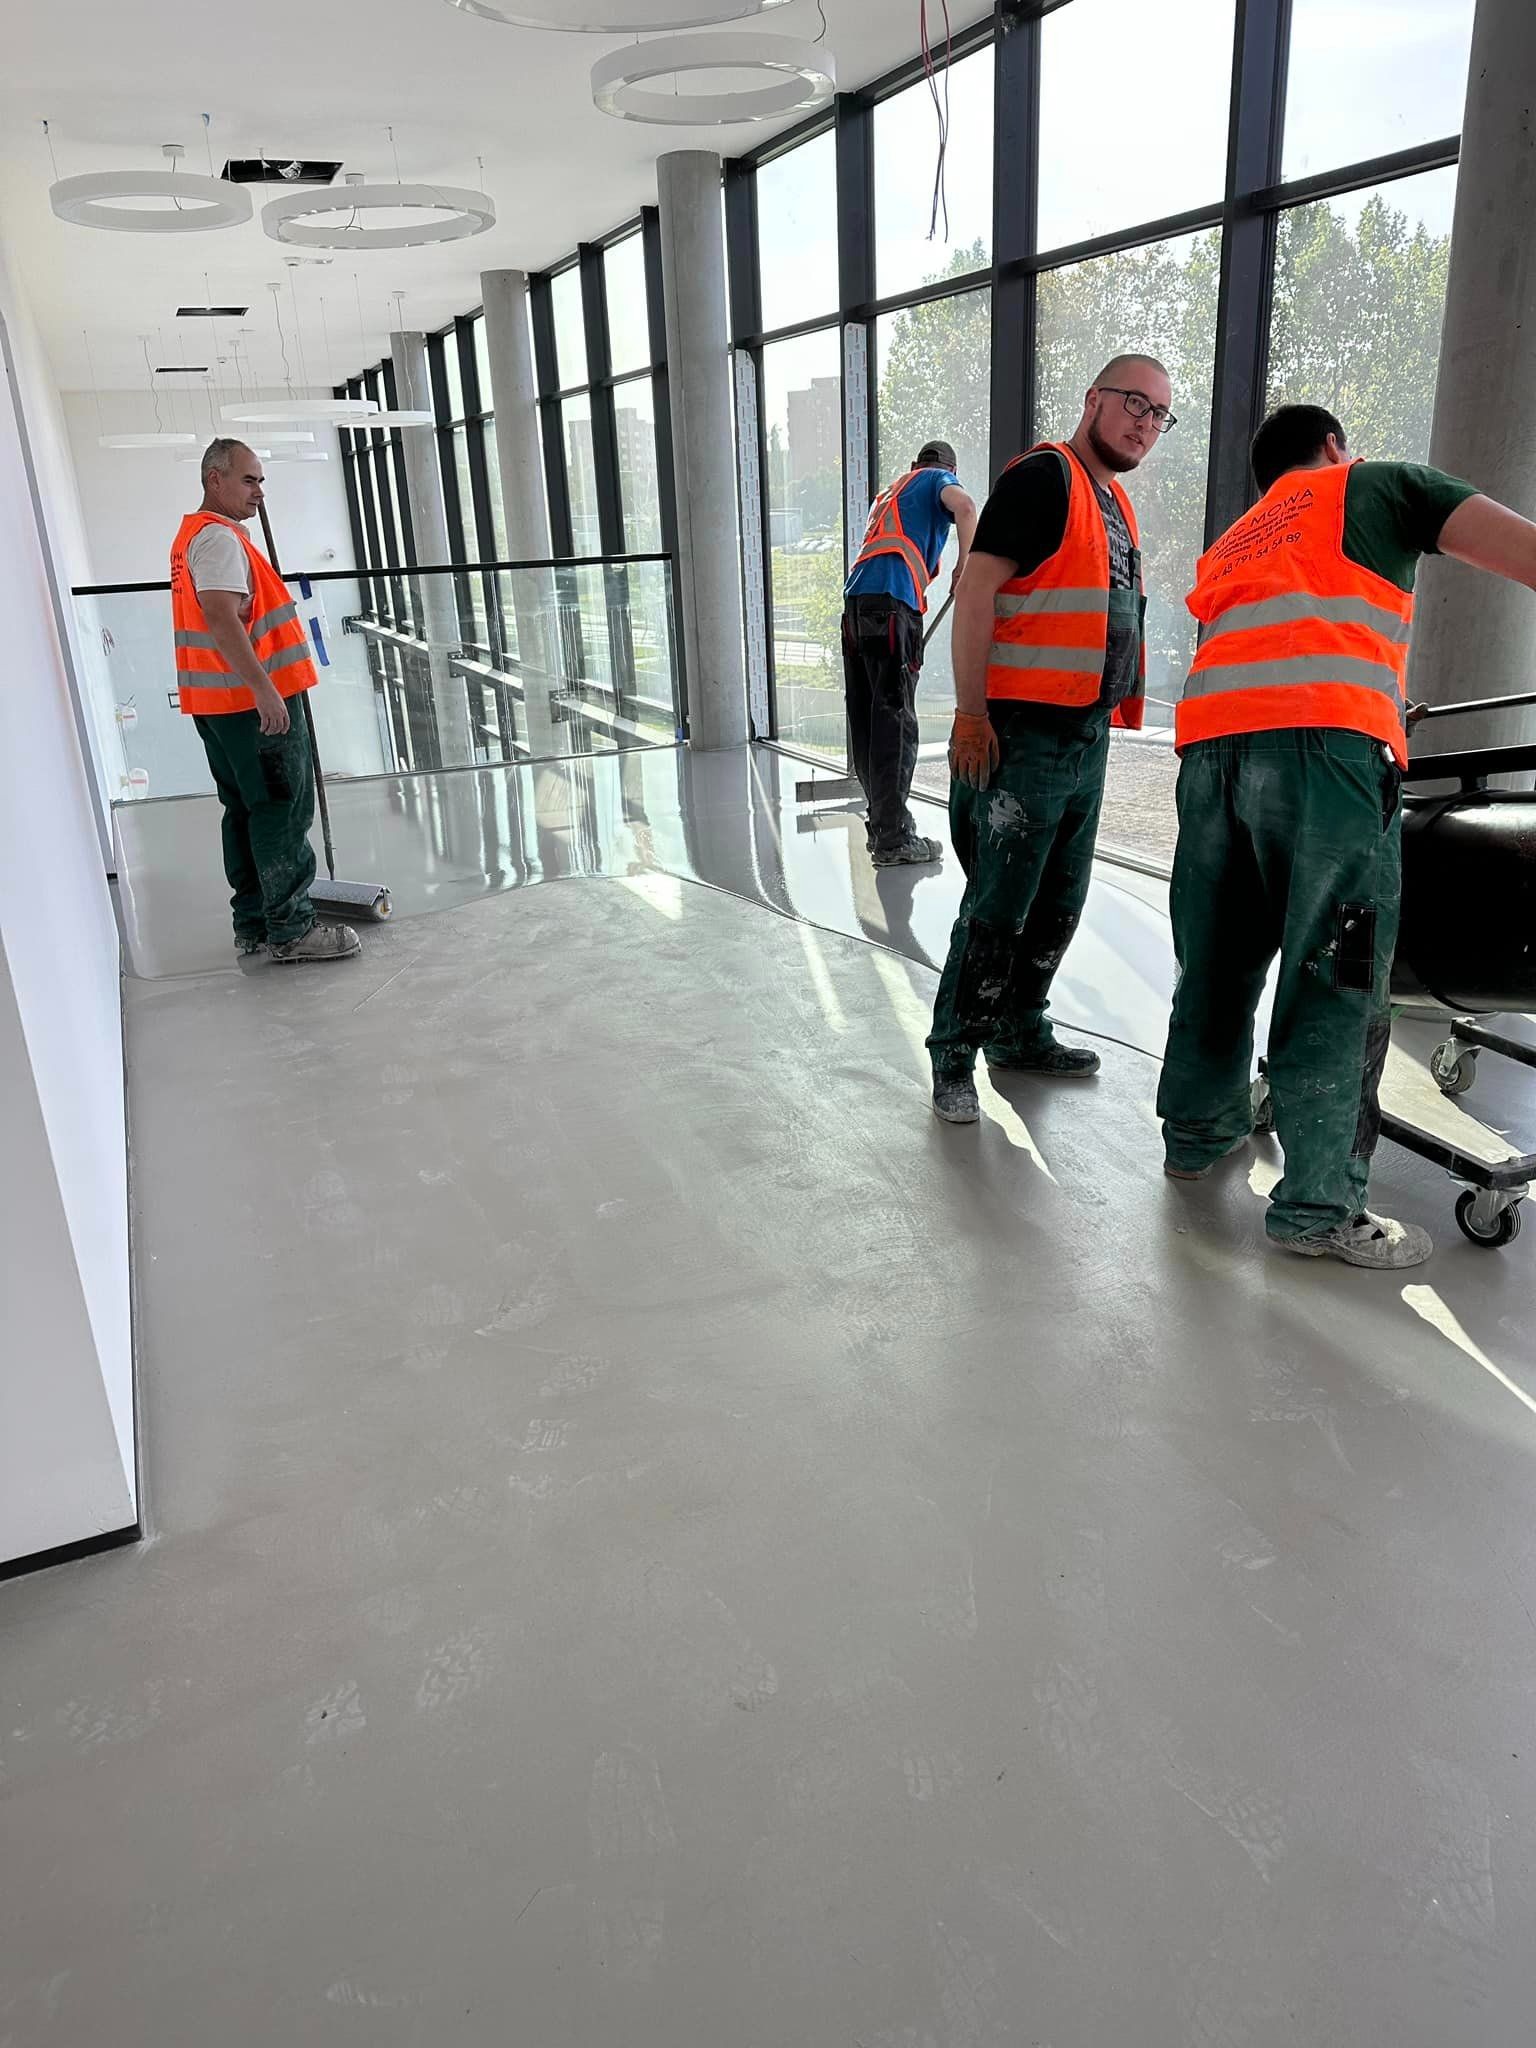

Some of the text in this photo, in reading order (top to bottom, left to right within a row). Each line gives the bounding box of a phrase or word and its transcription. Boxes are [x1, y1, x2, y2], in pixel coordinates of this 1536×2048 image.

[1250, 488, 1313, 527] MOWA
[1235, 553, 1252, 567] 791
[1286, 531, 1301, 543] 89
